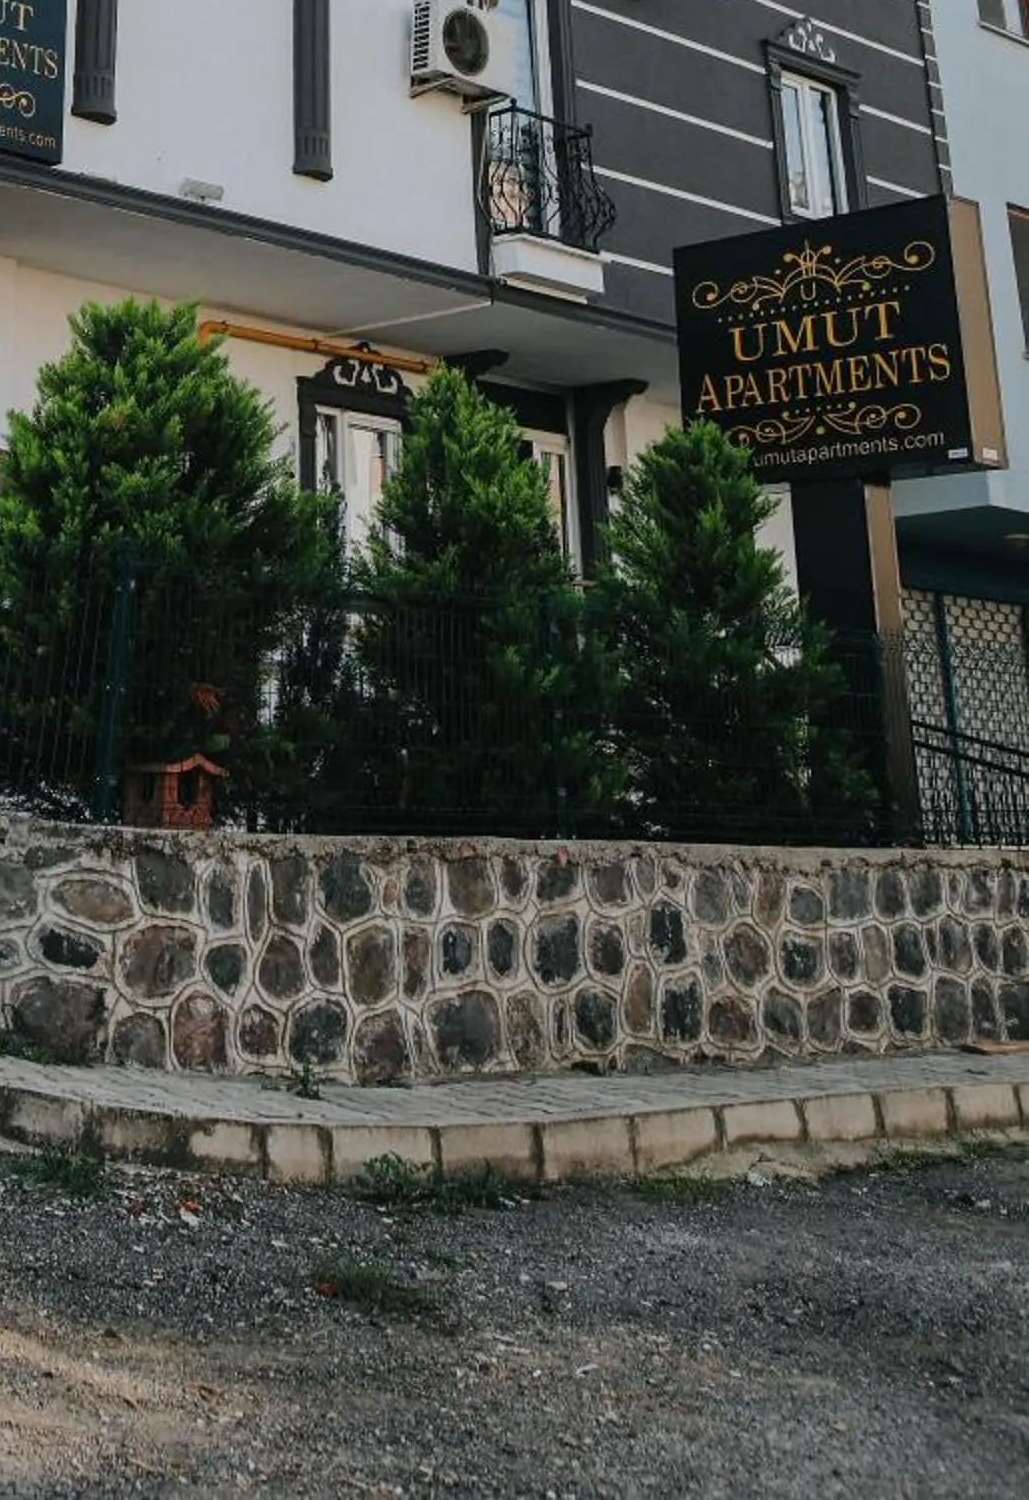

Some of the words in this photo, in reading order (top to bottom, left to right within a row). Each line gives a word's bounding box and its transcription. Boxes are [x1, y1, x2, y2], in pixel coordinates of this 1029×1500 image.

[728, 301, 902, 362] UMUT
[695, 343, 952, 414] APARTMENTS
[753, 432, 945, 467] umutapartments.com
